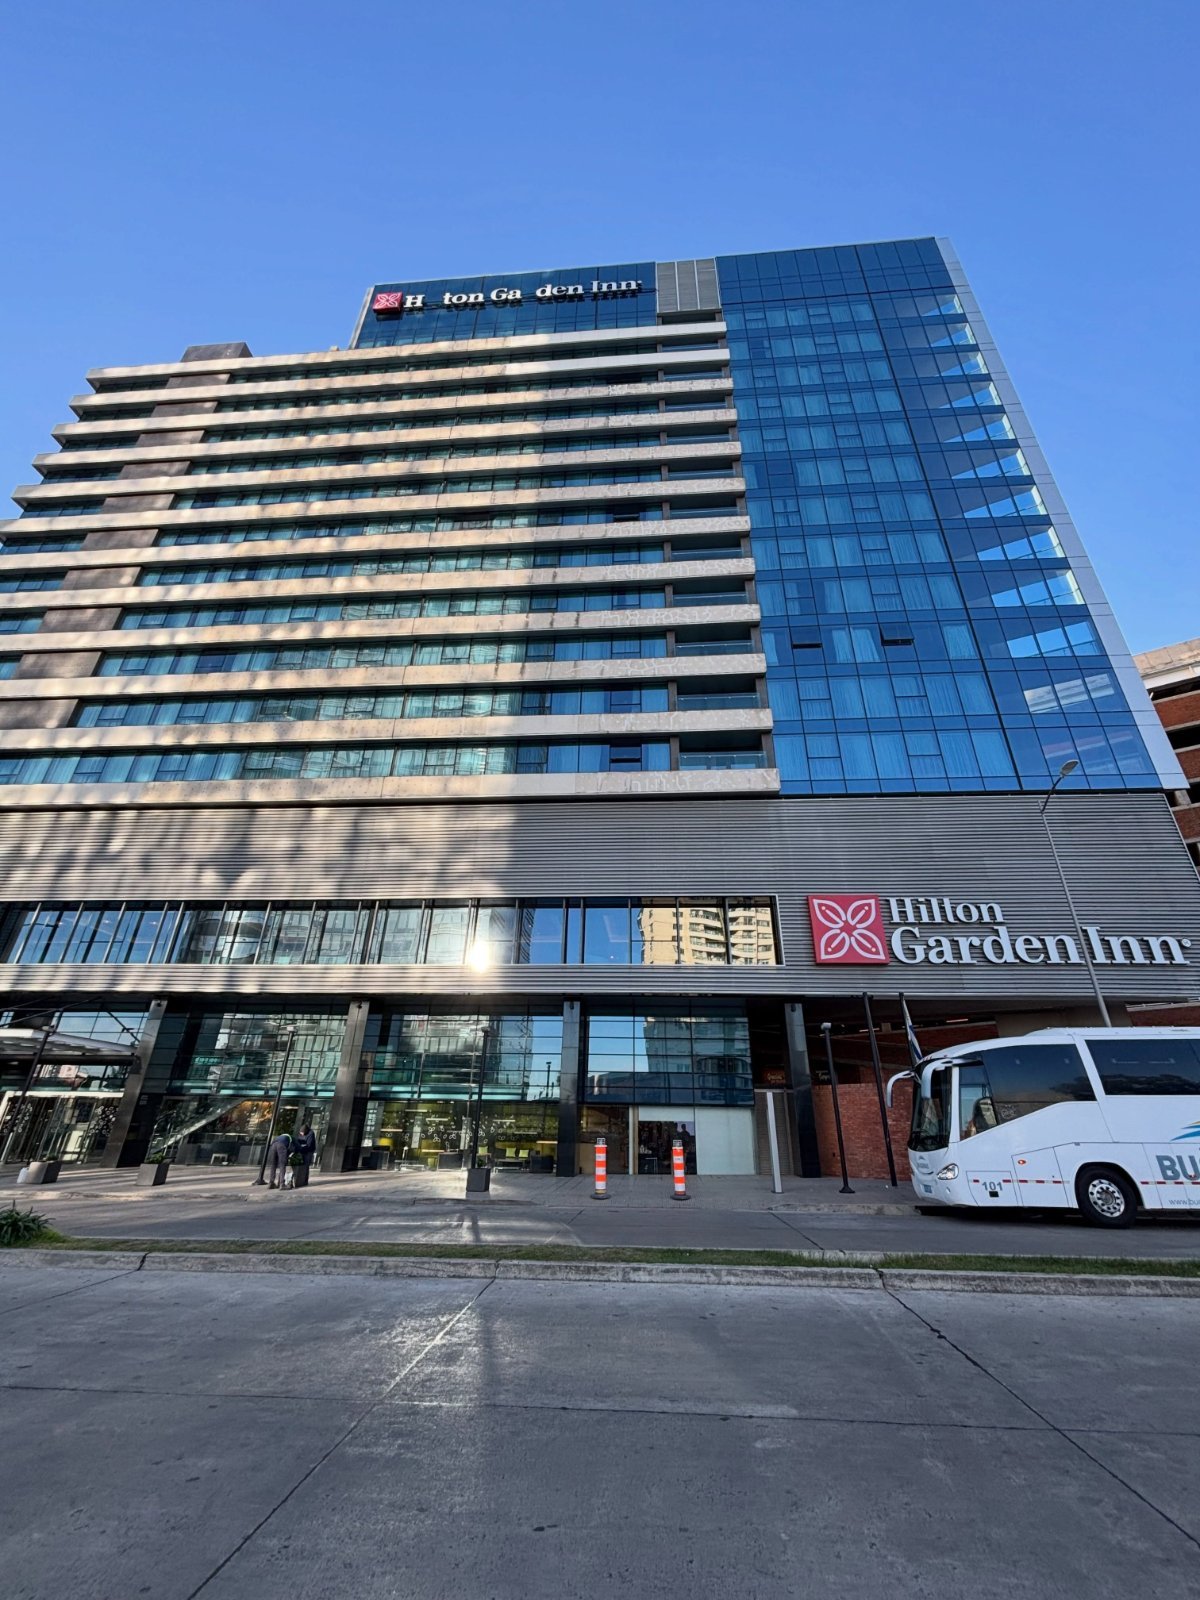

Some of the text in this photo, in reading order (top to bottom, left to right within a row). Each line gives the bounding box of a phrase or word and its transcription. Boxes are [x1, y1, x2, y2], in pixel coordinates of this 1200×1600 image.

[887, 897, 1005, 923] Hilton
[891, 926, 1086, 964] Garden
[1156, 1155, 1200, 1181] BU
[982, 1182, 1003, 1191] 101
